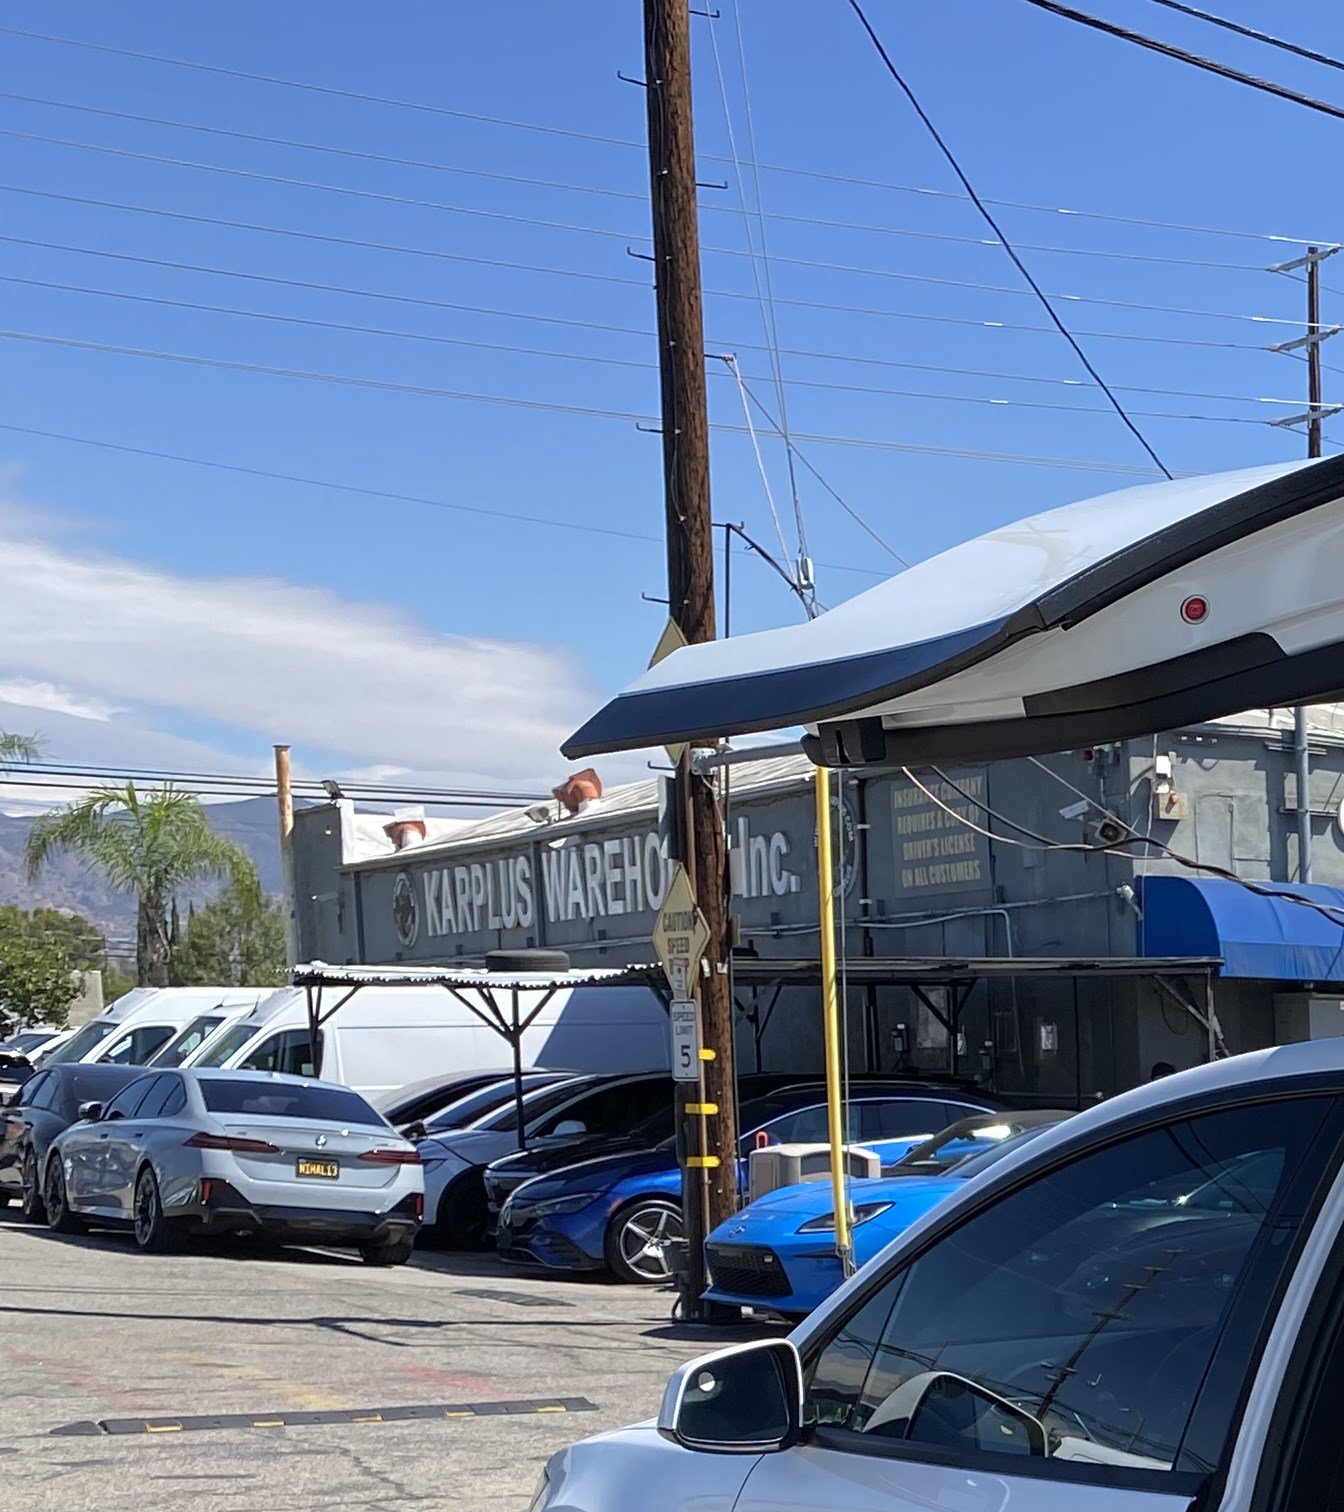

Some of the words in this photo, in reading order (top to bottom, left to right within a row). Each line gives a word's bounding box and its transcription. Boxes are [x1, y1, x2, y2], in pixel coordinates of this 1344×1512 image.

[941, 832, 975, 856] LICENSE
[423, 855, 534, 936] KARPLUS
[542, 832, 676, 922] WAREHO
[738, 817, 799, 898] Inc.
[928, 860, 980, 884] CUSTOMERS
[667, 936, 689, 954] SPEED
[673, 1011, 695, 1021] SPEED
[675, 1025, 693, 1036] LIMIT
[681, 1044, 691, 1068] 5
